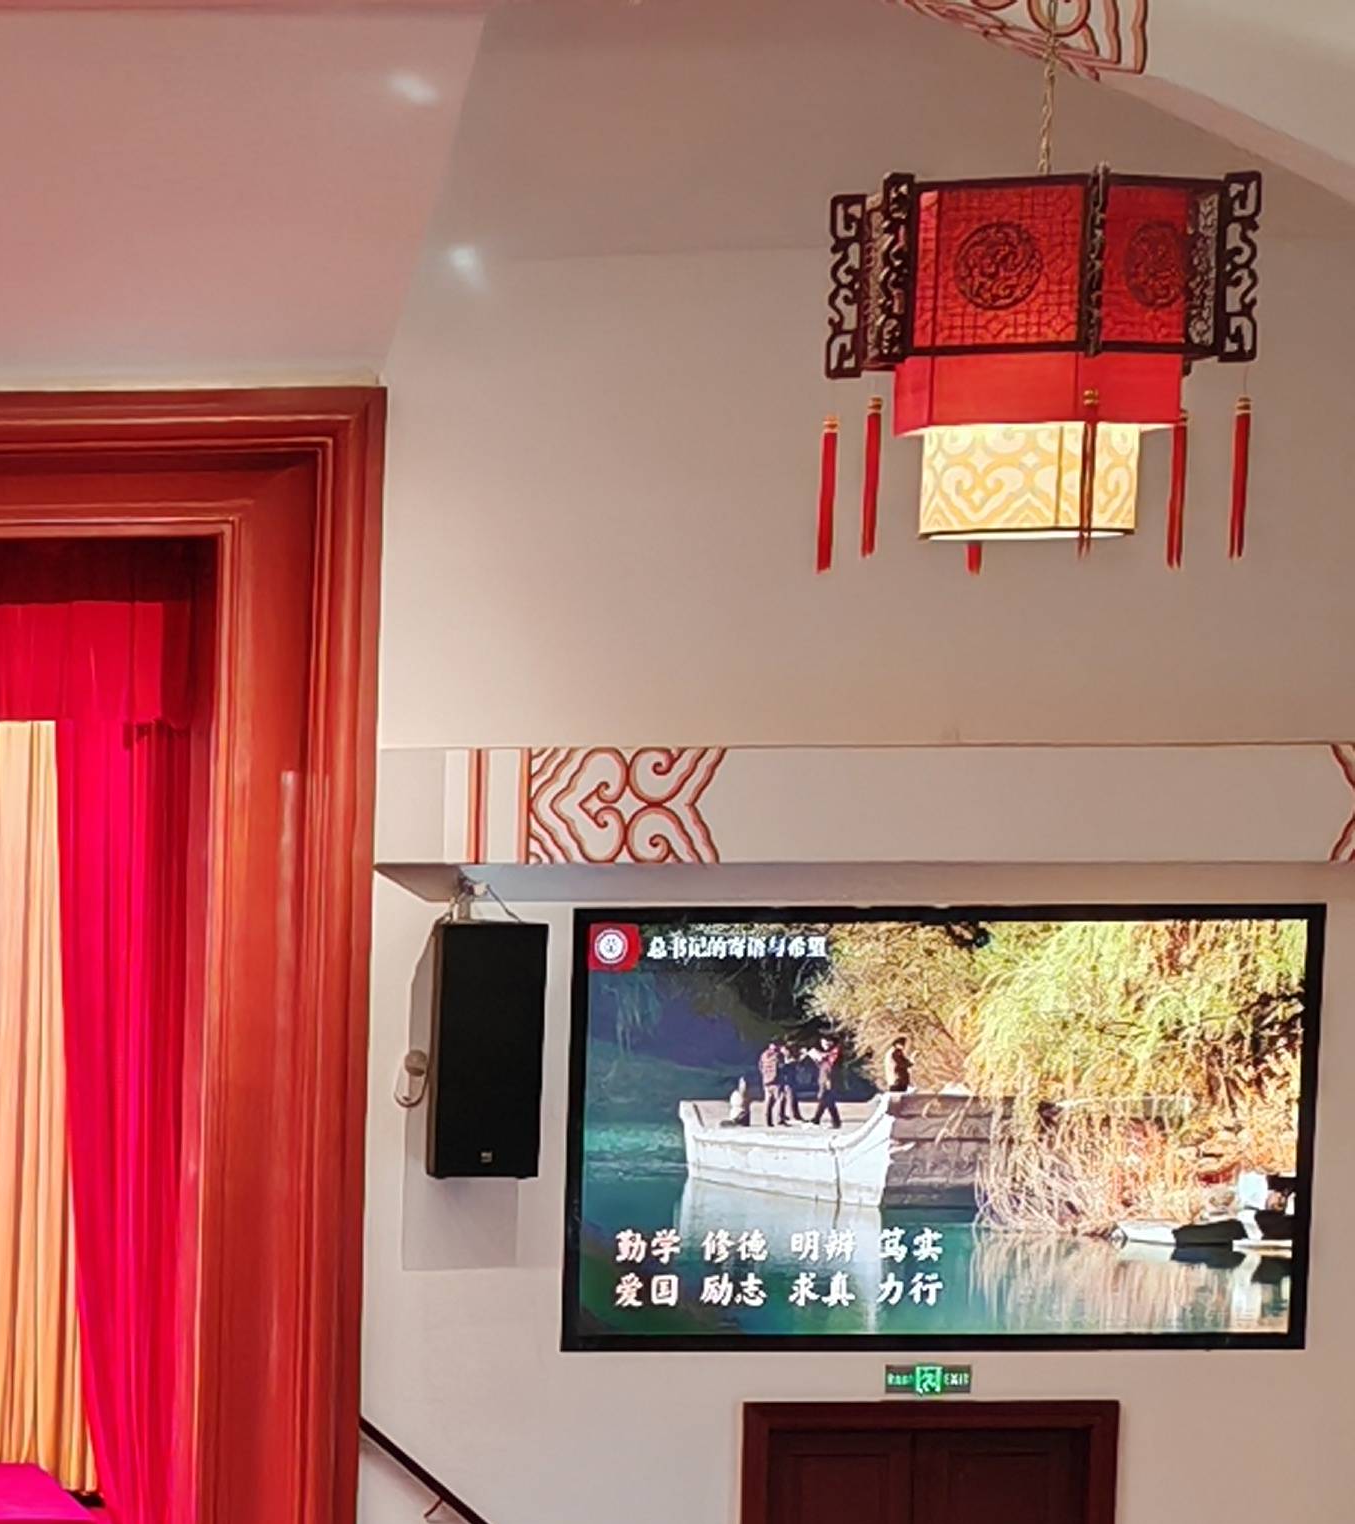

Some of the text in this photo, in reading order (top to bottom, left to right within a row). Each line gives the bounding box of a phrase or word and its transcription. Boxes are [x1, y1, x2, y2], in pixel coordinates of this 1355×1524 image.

[614, 1227, 943, 1263] 勤学 修德 明辨 笃实
[614, 1272, 943, 1308] 爱国 励志 求真 力行
